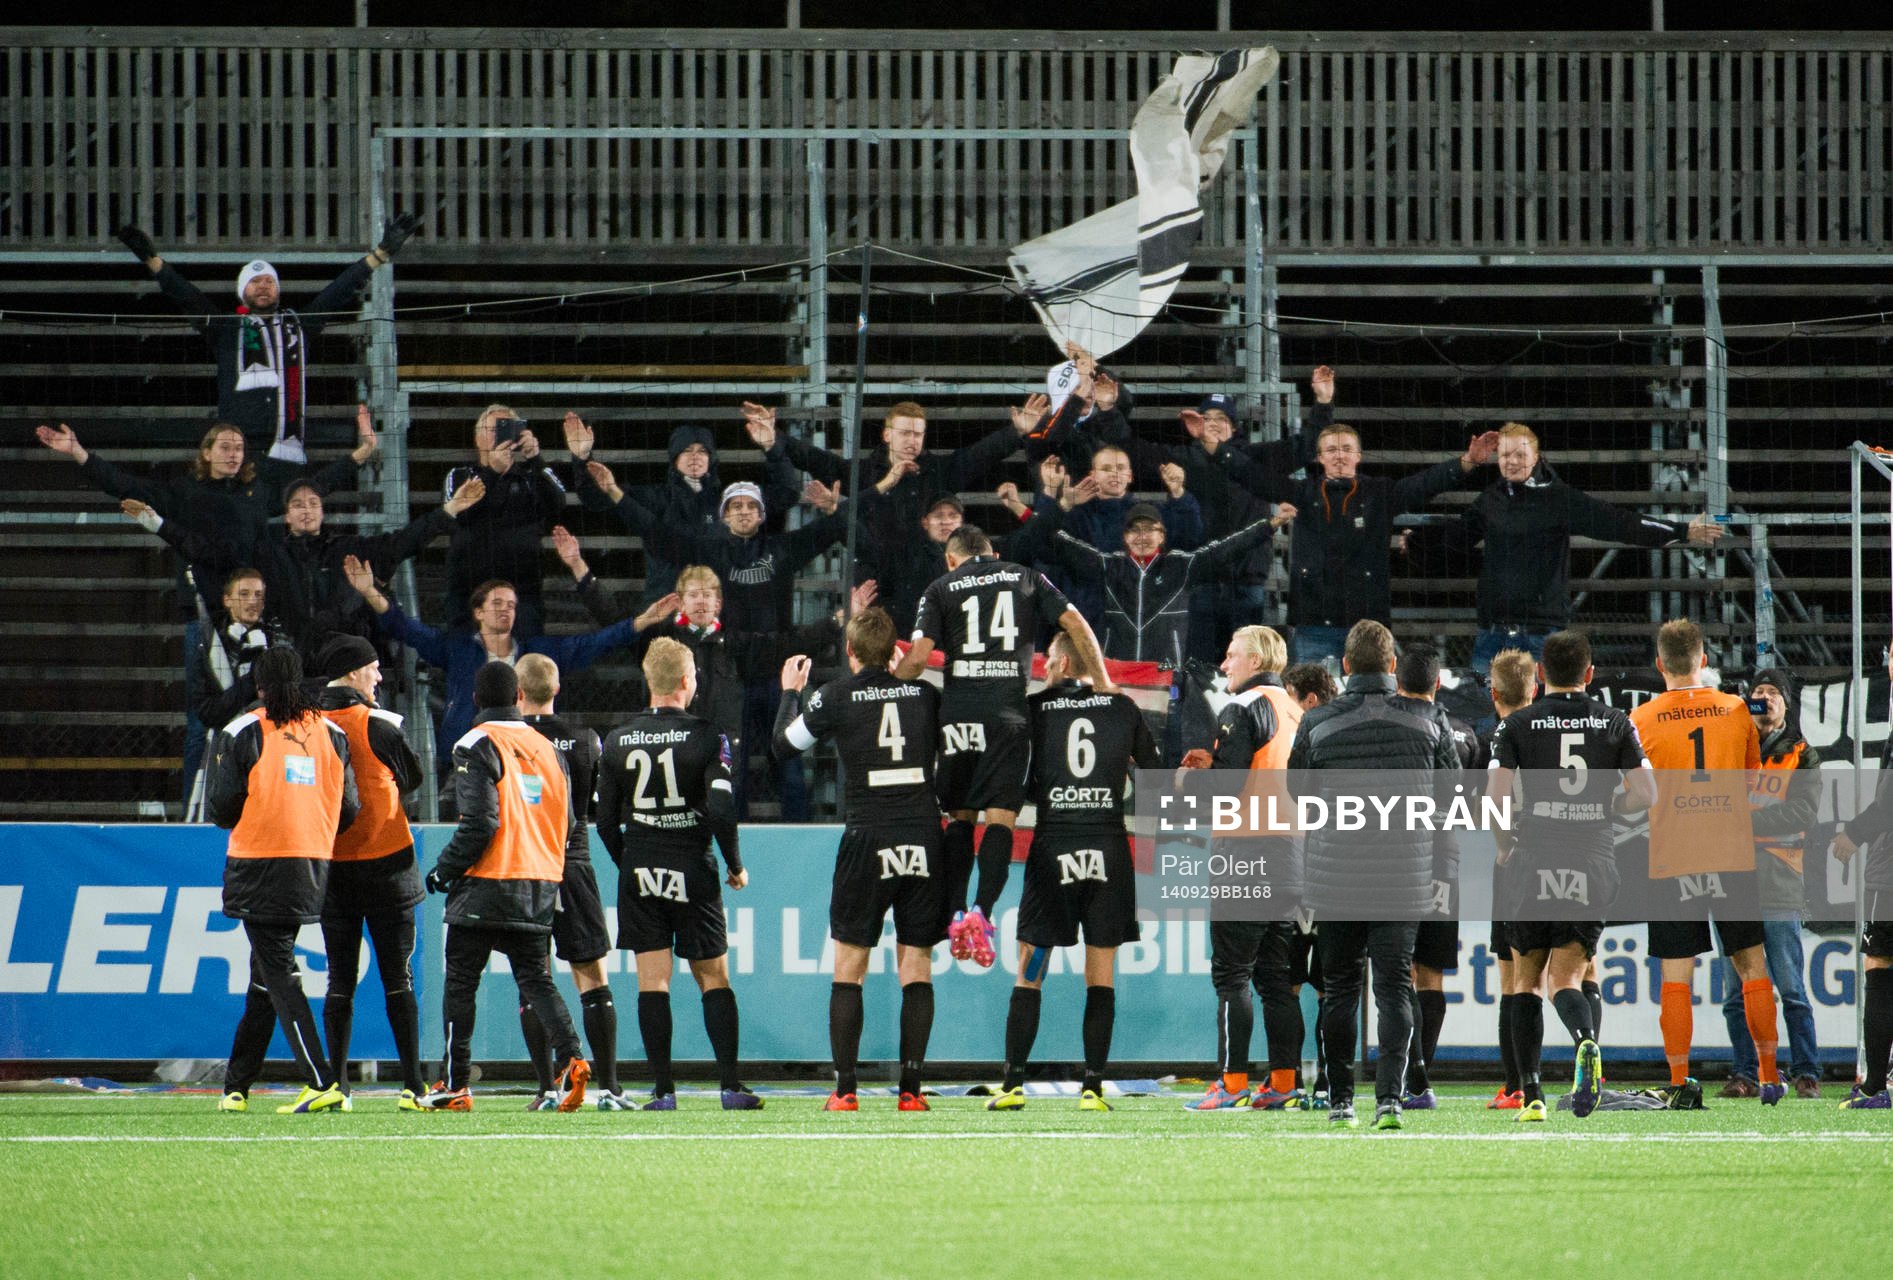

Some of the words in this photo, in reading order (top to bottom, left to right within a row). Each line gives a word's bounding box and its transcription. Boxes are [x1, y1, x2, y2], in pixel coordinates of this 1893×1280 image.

[949, 570, 1021, 591] mätcenter
[961, 590, 1019, 654] 14
[985, 661, 1010, 669] BYGG
[852, 684, 921, 702] mätcenter
[1042, 695, 1113, 711] mätcenter
[1531, 715, 1610, 729] mätcenter
[1657, 704, 1733, 722] mätcenter
[619, 729, 691, 746] mätcenter
[878, 702, 905, 761] 4
[943, 723, 986, 755] NA
[1067, 717, 1096, 779] 6
[1687, 726, 1711, 782] 1
[626, 748, 686, 809] 21
[1559, 733, 1588, 796] 5
[1049, 785, 1113, 802] GÖRTZ
[1568, 803, 1594, 812] BYGG
[1673, 795, 1731, 809] GÖRTZ
[877, 845, 930, 880] NA
[1057, 849, 1108, 885] NA
[635, 867, 689, 903] NA
[1537, 869, 1590, 906] NA
[1675, 871, 1727, 902] NA
